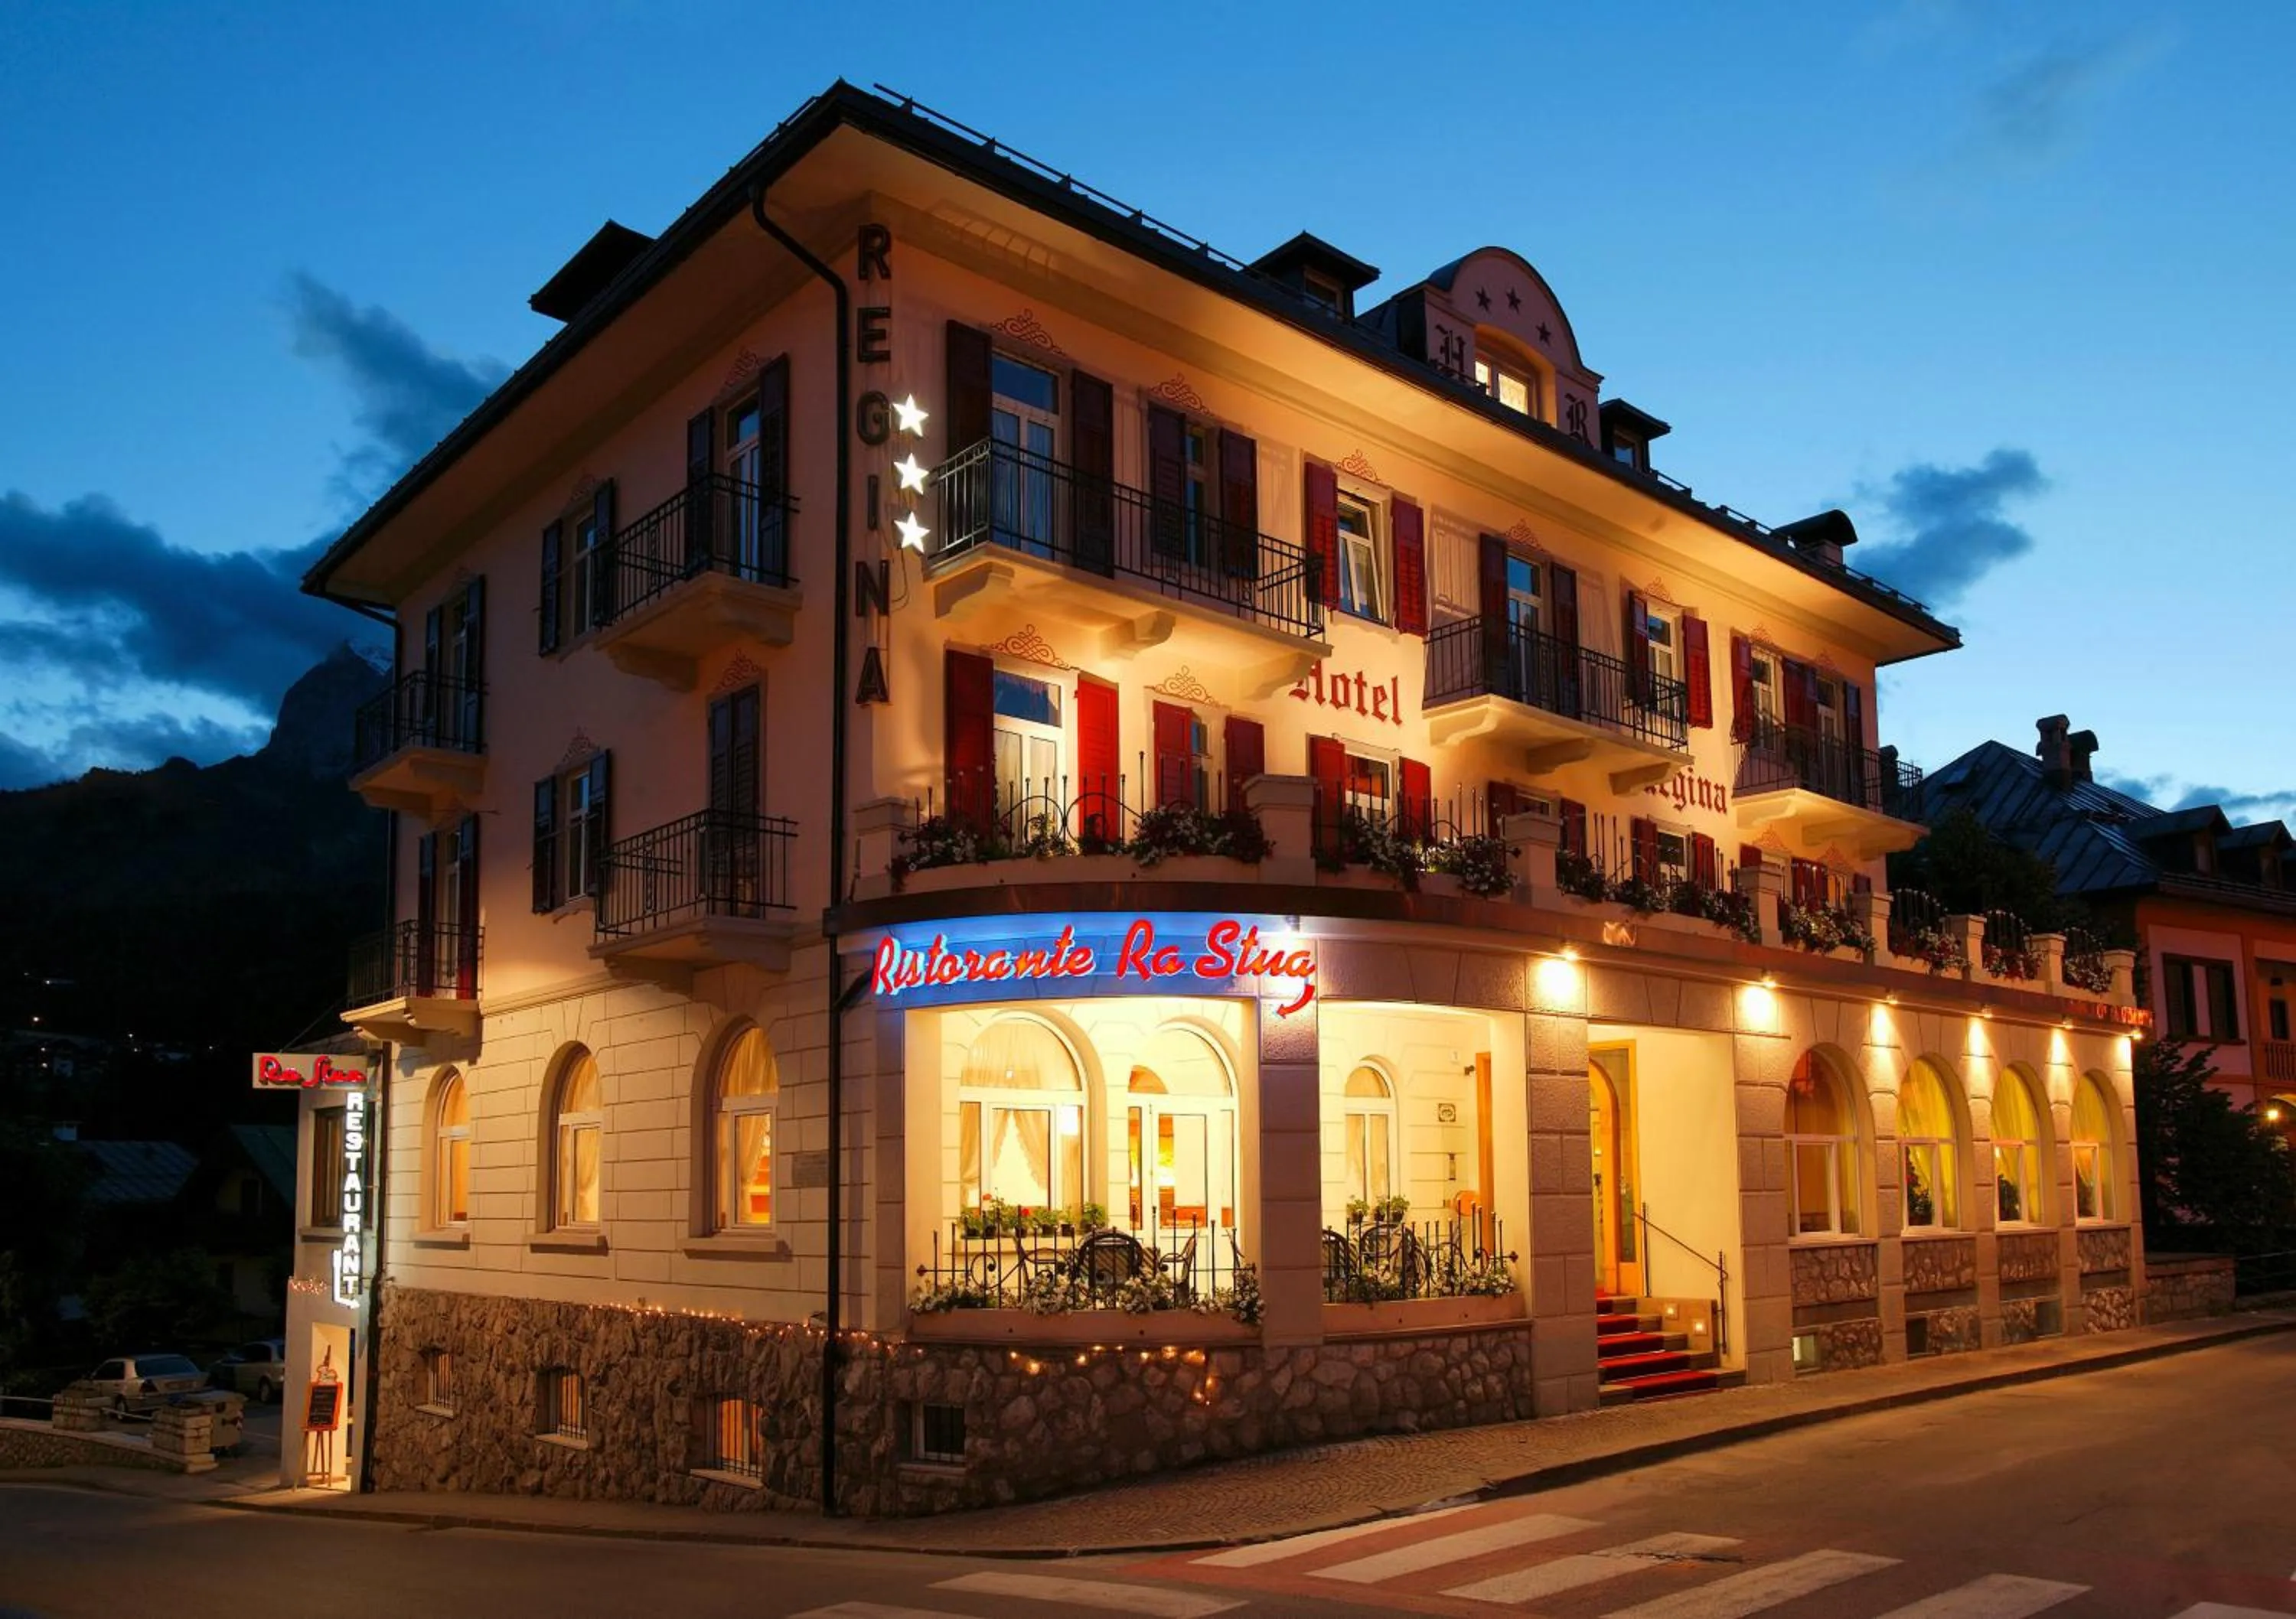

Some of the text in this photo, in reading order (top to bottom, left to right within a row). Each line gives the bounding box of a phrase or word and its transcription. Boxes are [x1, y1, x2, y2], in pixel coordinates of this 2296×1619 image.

[856, 223, 892, 705] REGINA
[1643, 767, 1727, 814] gina
[871, 919, 1315, 995] Ristorante Ra Stua
[259, 1055, 302, 1085] Ra
[341, 1092, 364, 1295] RESTAURANT
